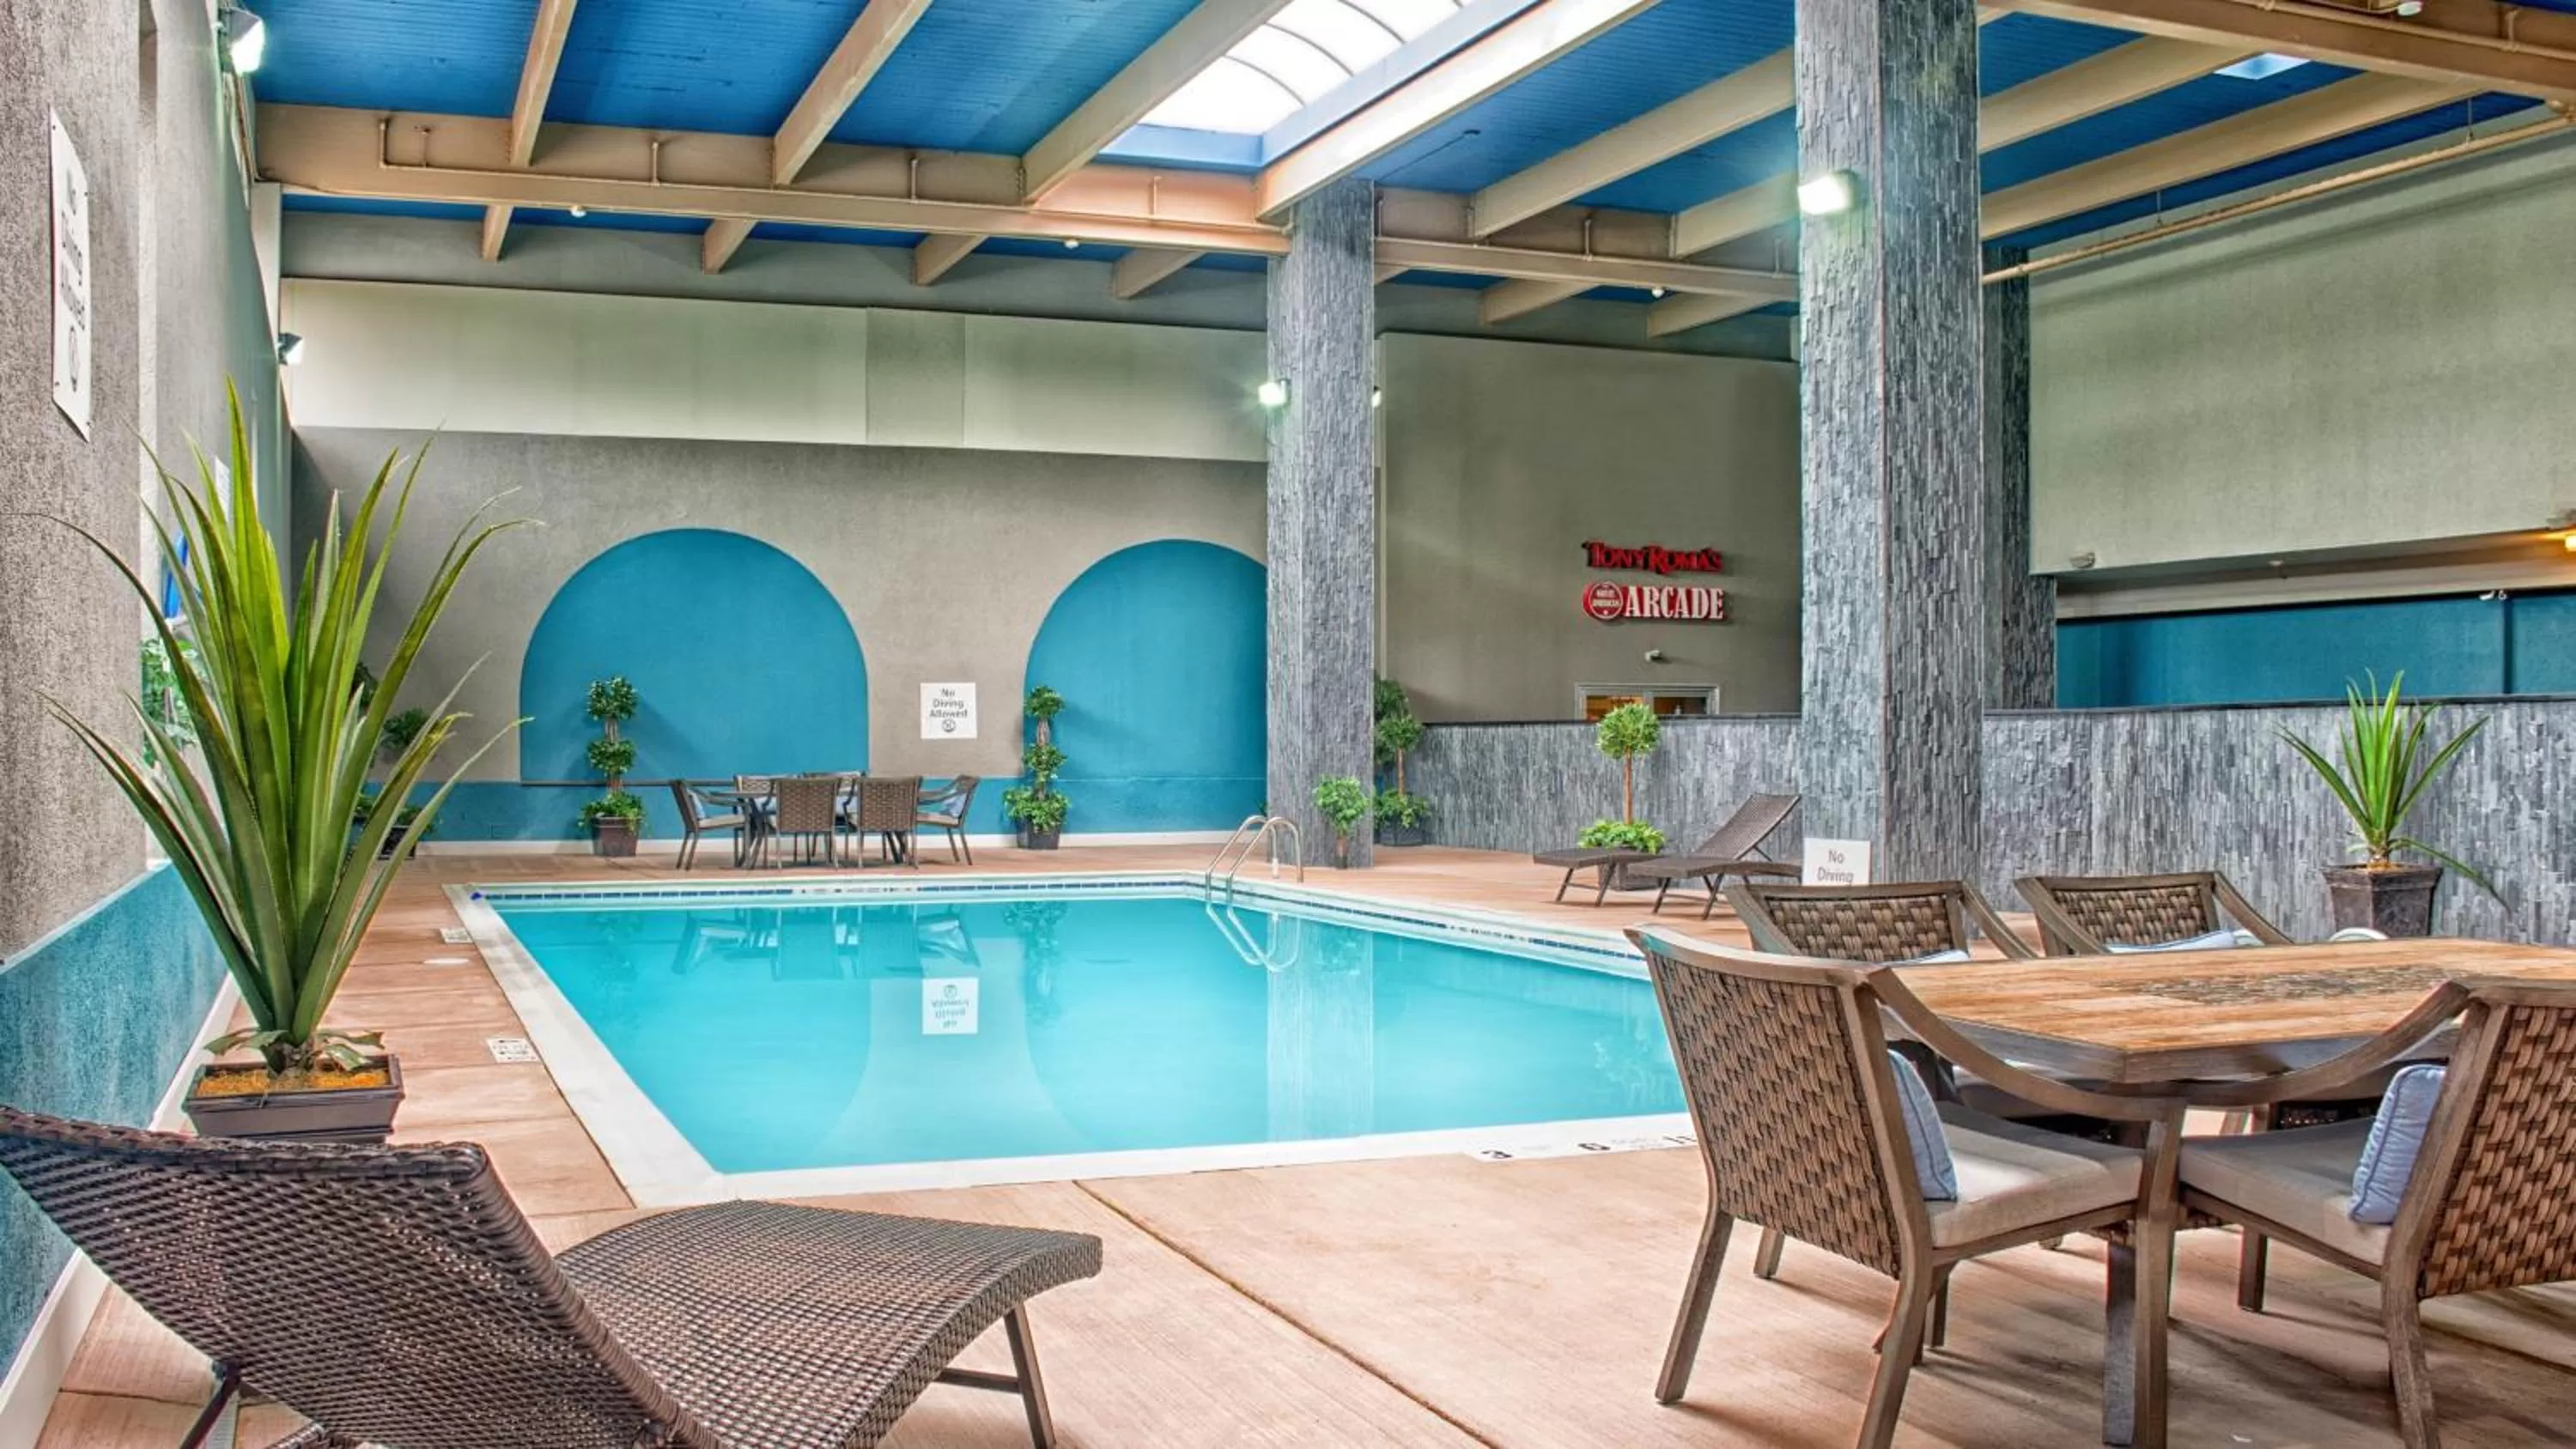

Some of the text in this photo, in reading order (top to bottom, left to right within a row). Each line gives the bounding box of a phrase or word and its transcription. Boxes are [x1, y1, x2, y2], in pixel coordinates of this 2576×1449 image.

[1624, 585, 1724, 619] ARCADE
[941, 688, 956, 698] No
[933, 698, 964, 710] Diving
[929, 709, 968, 718] Allowed
[1828, 849, 1845, 864] No
[1817, 866, 1854, 885] Diving
